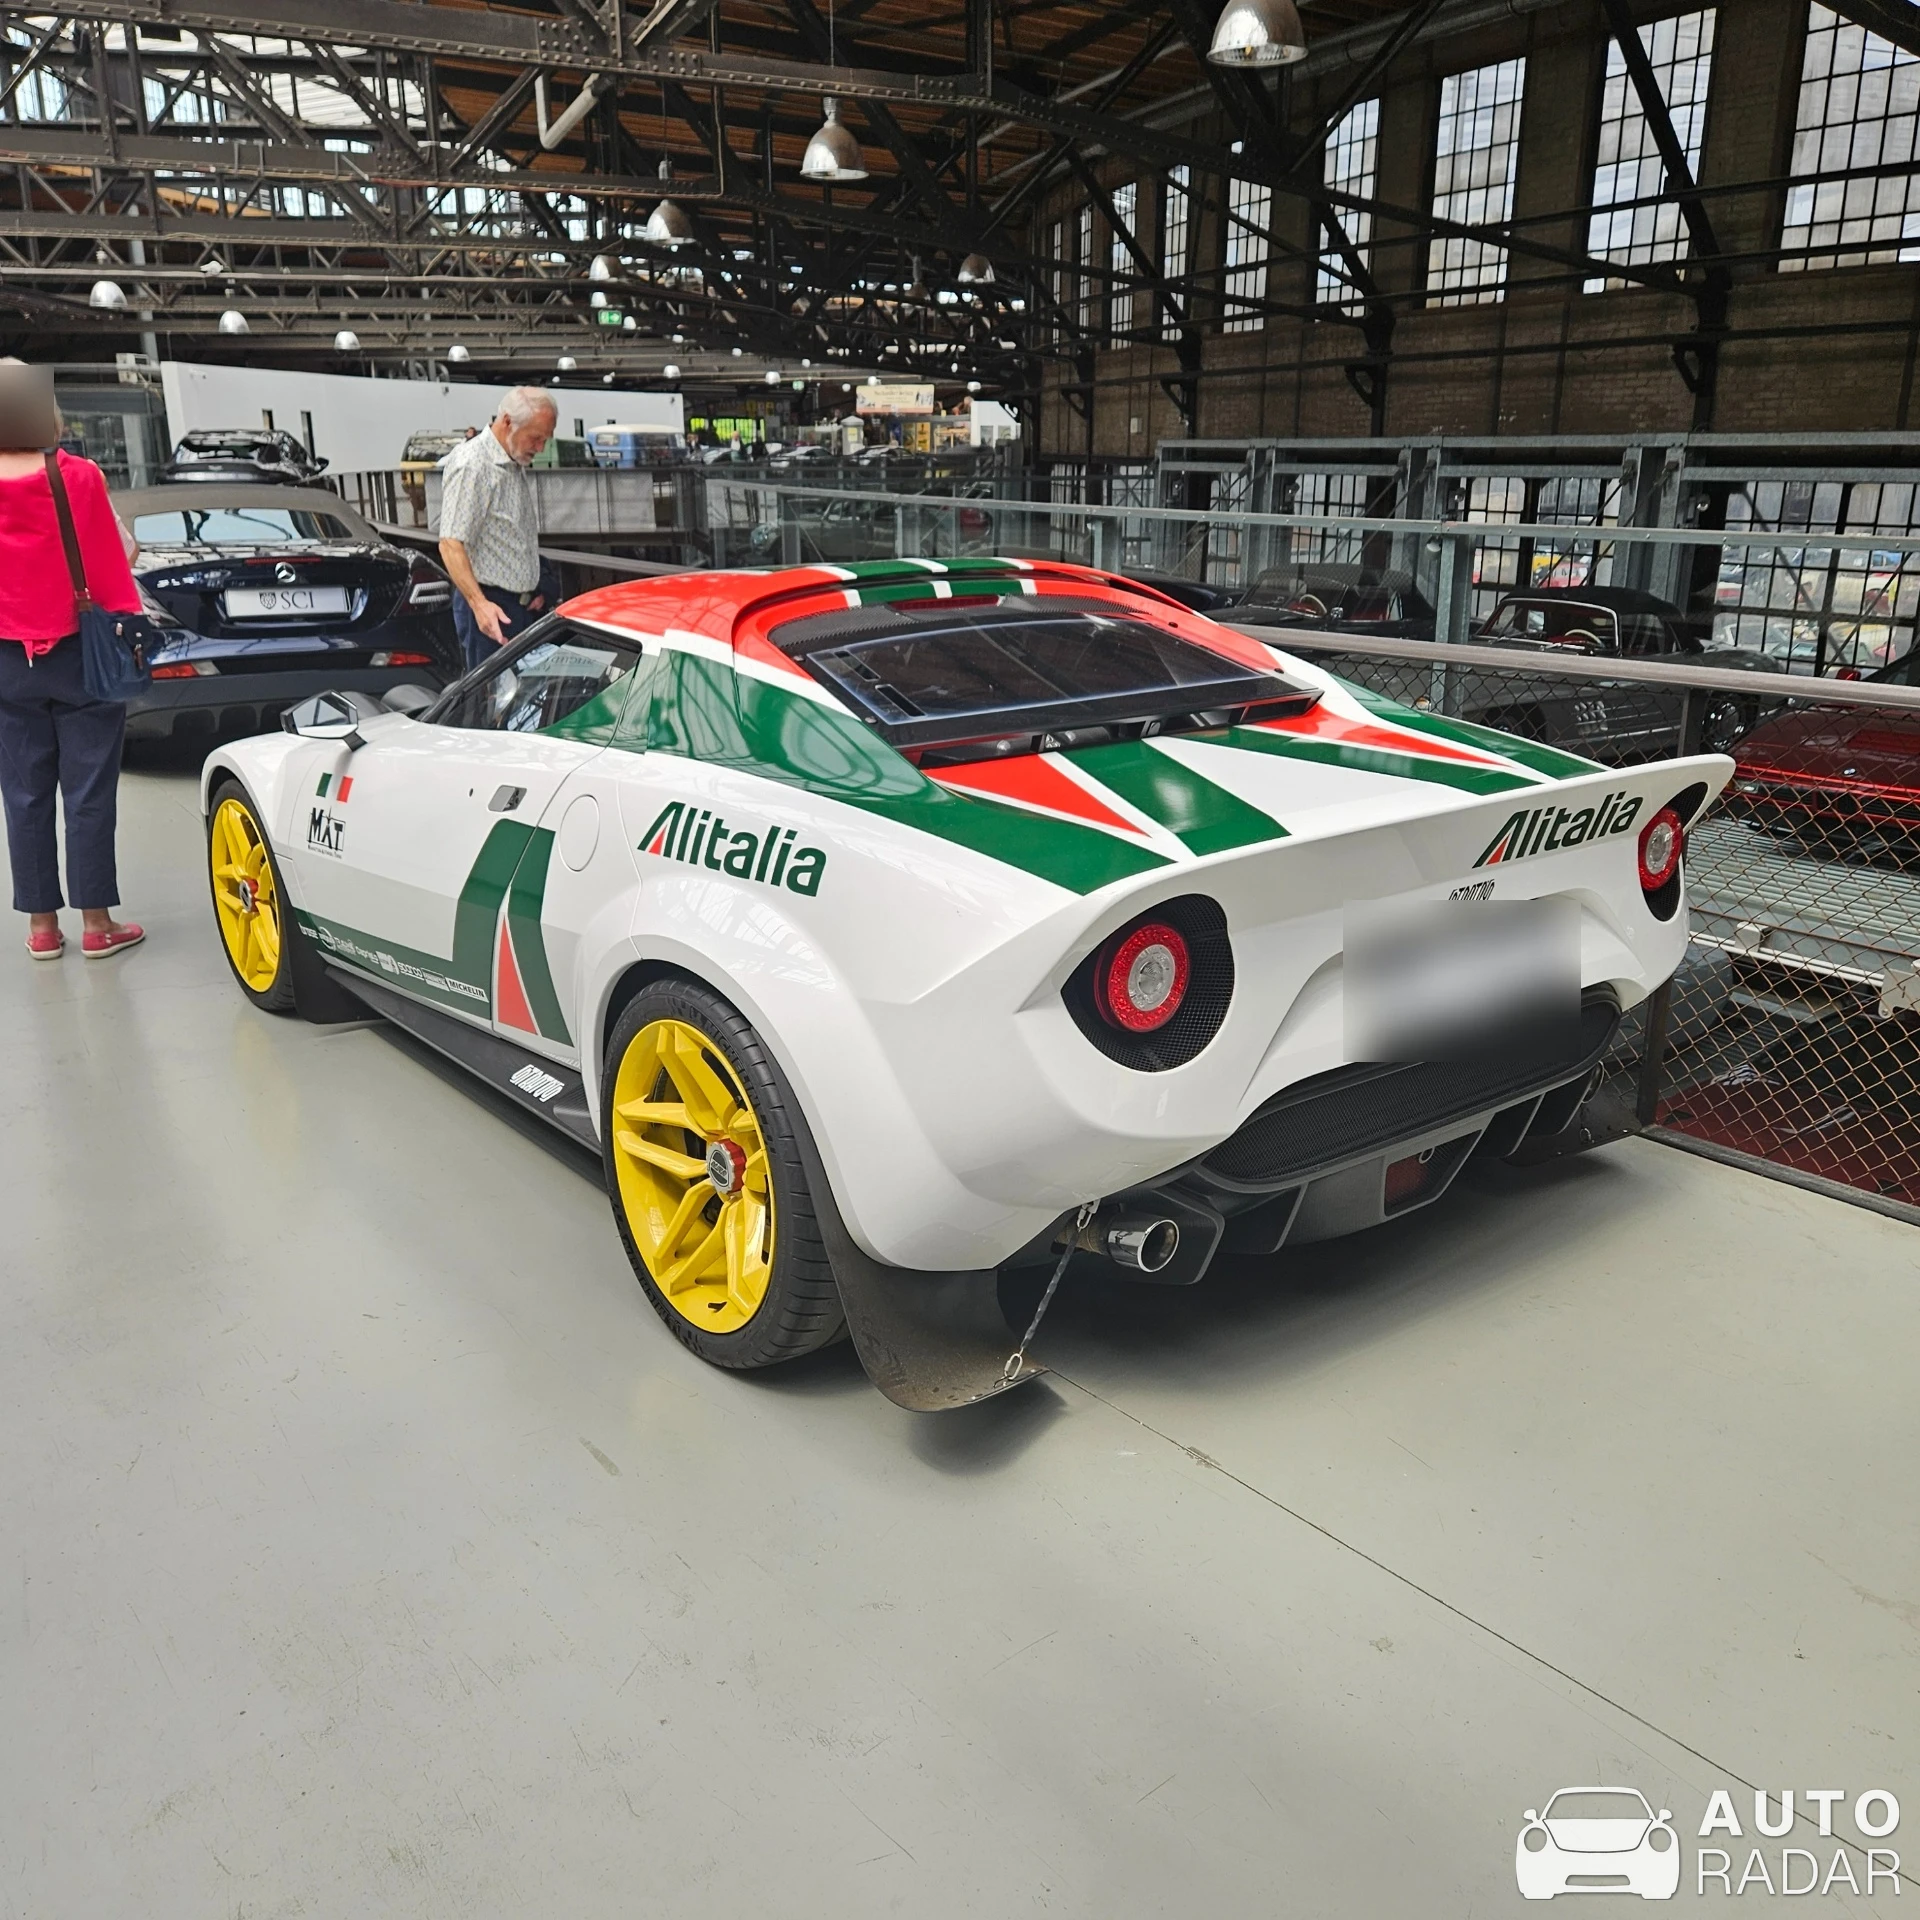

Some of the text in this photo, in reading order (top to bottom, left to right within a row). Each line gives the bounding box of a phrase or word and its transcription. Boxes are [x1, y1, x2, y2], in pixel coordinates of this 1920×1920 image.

[280, 590, 315, 610] SCI
[308, 806, 344, 851] MAT
[637, 801, 827, 897] Alitalia
[1471, 791, 1644, 869] Alitalia
[448, 979, 485, 998] MICHELIN
